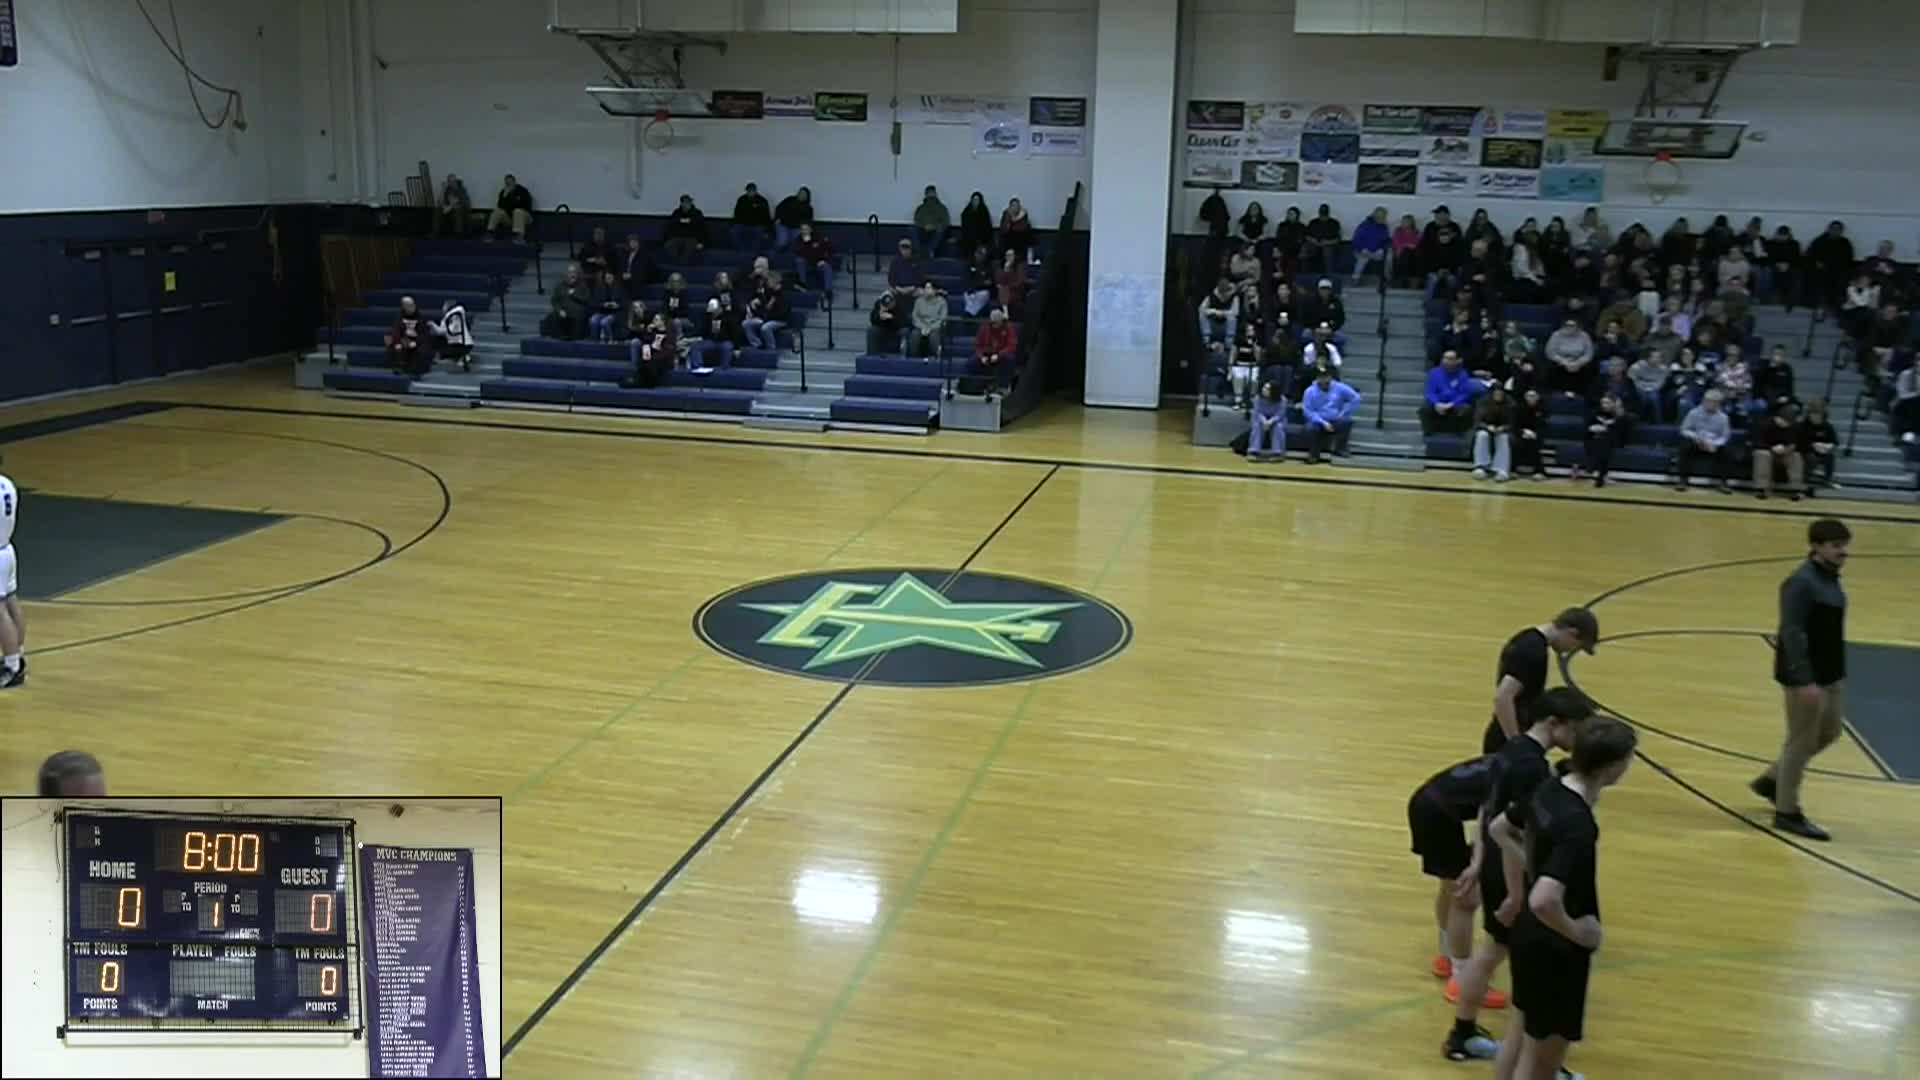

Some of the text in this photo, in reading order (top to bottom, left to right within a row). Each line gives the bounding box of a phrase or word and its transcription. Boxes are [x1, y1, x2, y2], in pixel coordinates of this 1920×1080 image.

[183, 831, 260, 872] 8:00
[376, 848, 457, 862] MVC CHAMPIONS
[89, 861, 136, 879] HOME
[281, 868, 329, 886] GUEST
[194, 881, 228, 894] PERIOD
[117, 887, 141, 927] 0
[213, 902, 220, 928] 1
[310, 893, 332, 932] 0
[73, 942, 128, 955] TM FOULS
[172, 944, 257, 957] PLAYER FOULS
[313, 948, 345, 960] FOULS
[101, 961, 119, 992] 0
[321, 966, 337, 995] 0
[83, 998, 118, 1010] POINTS
[197, 999, 228, 1010] MATCH
[305, 1001, 337, 1012] POINTS
